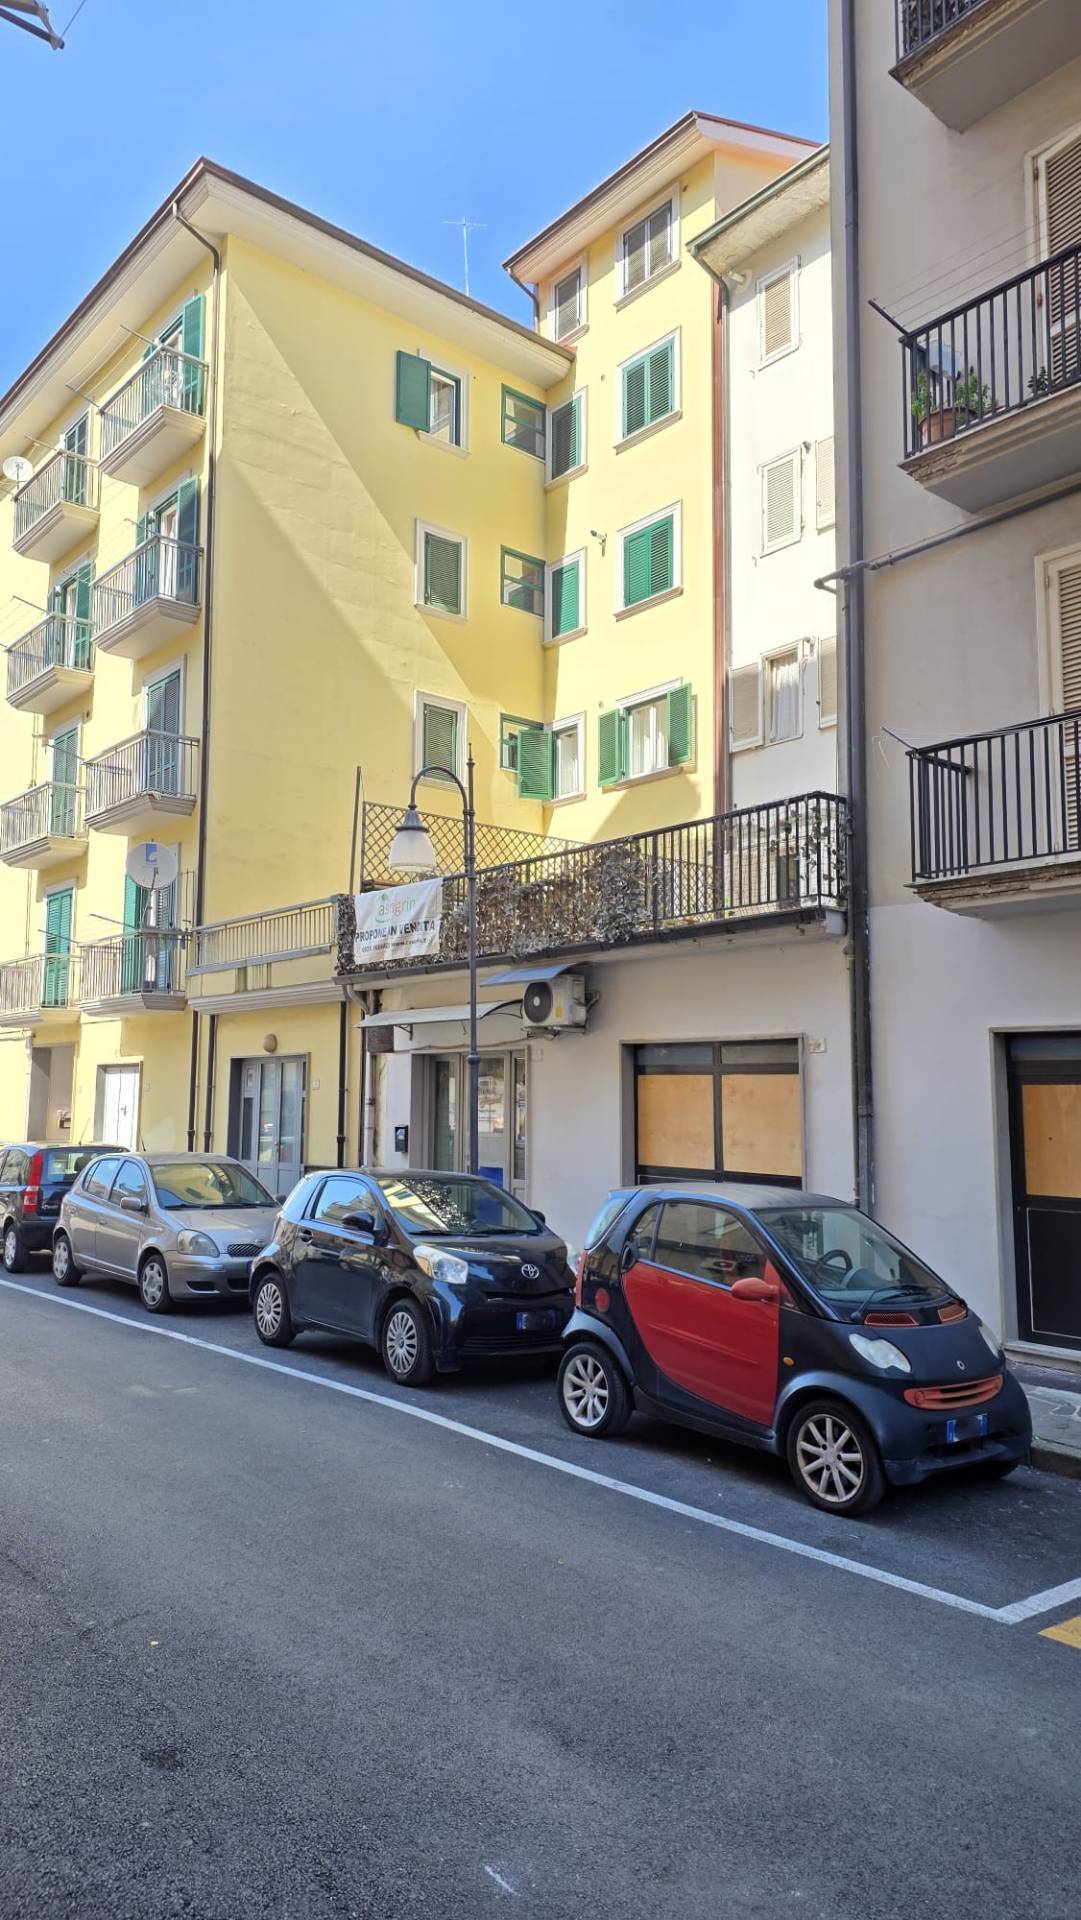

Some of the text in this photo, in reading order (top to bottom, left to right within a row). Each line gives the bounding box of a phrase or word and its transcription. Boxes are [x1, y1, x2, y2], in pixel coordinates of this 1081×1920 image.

[355, 920, 435, 942] PROPONE IN VENTA
